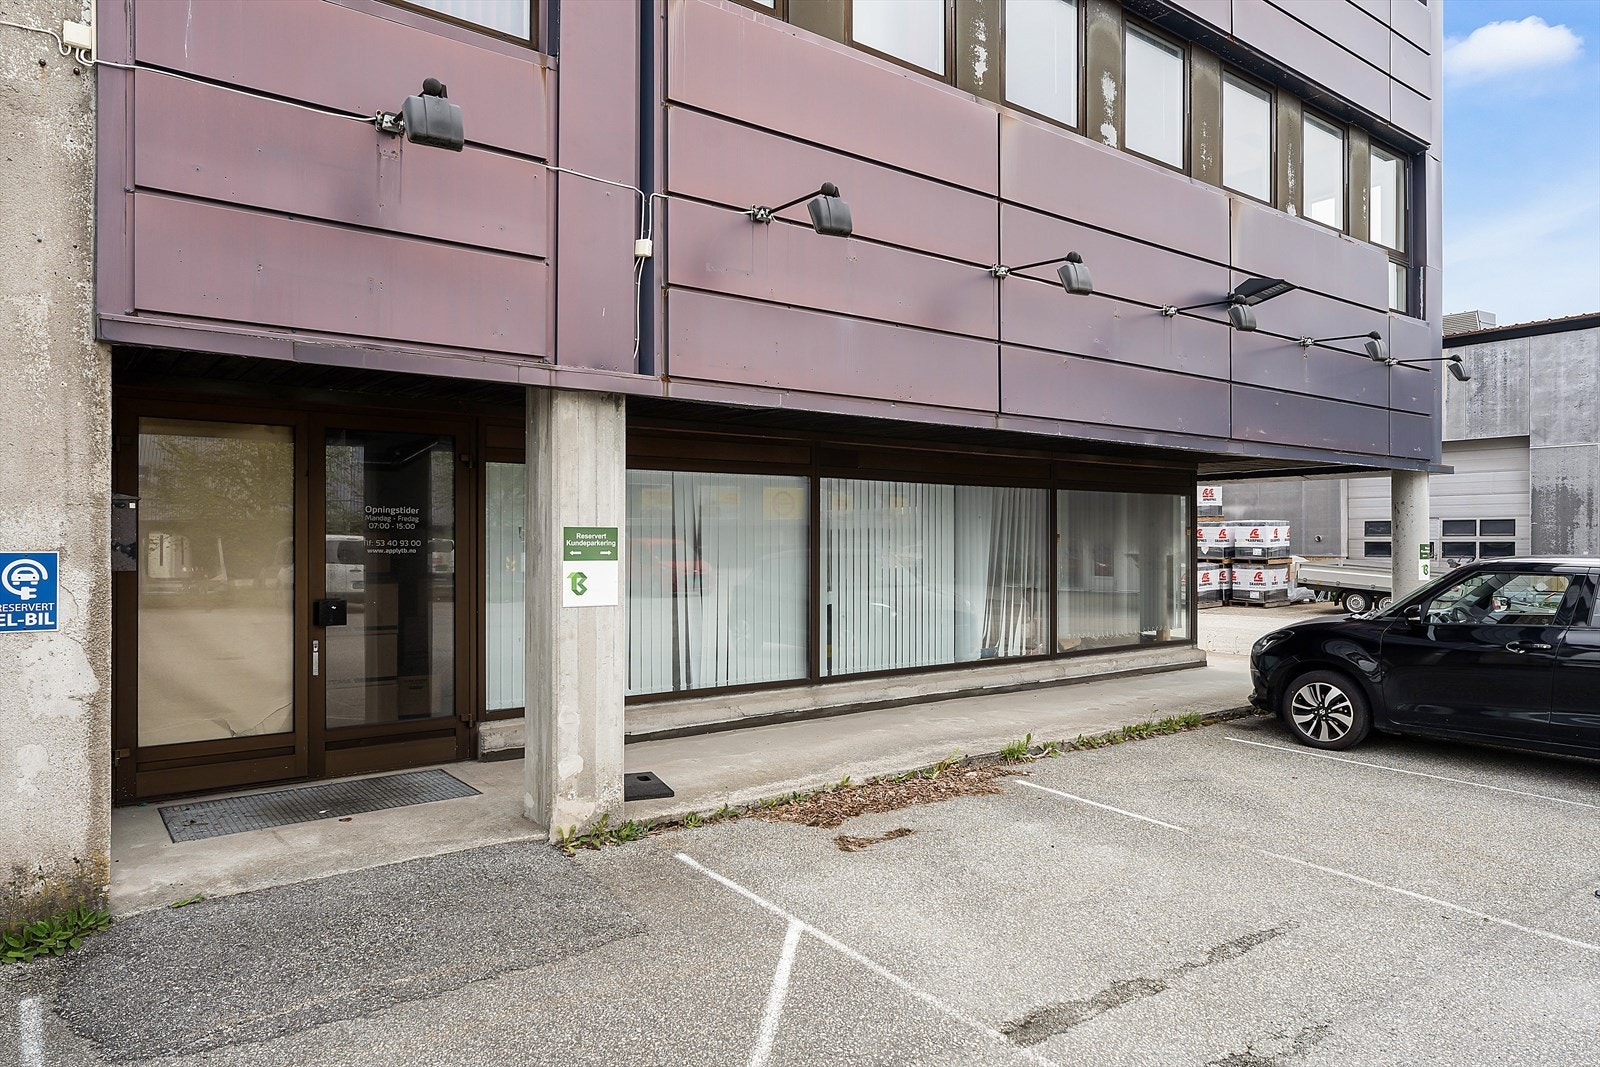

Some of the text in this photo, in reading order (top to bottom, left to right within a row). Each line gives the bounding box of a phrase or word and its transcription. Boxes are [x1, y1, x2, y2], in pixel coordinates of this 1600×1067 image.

[364, 505, 420, 515] Opningstider
[364, 515, 392, 523] Mandag
[397, 515, 420, 523] Fredag
[368, 522, 390, 530] 07:00
[576, 532, 607, 540] Reservert
[566, 540, 616, 548] Kundeparkering
[0, 612, 55, 627] EL-BIL
